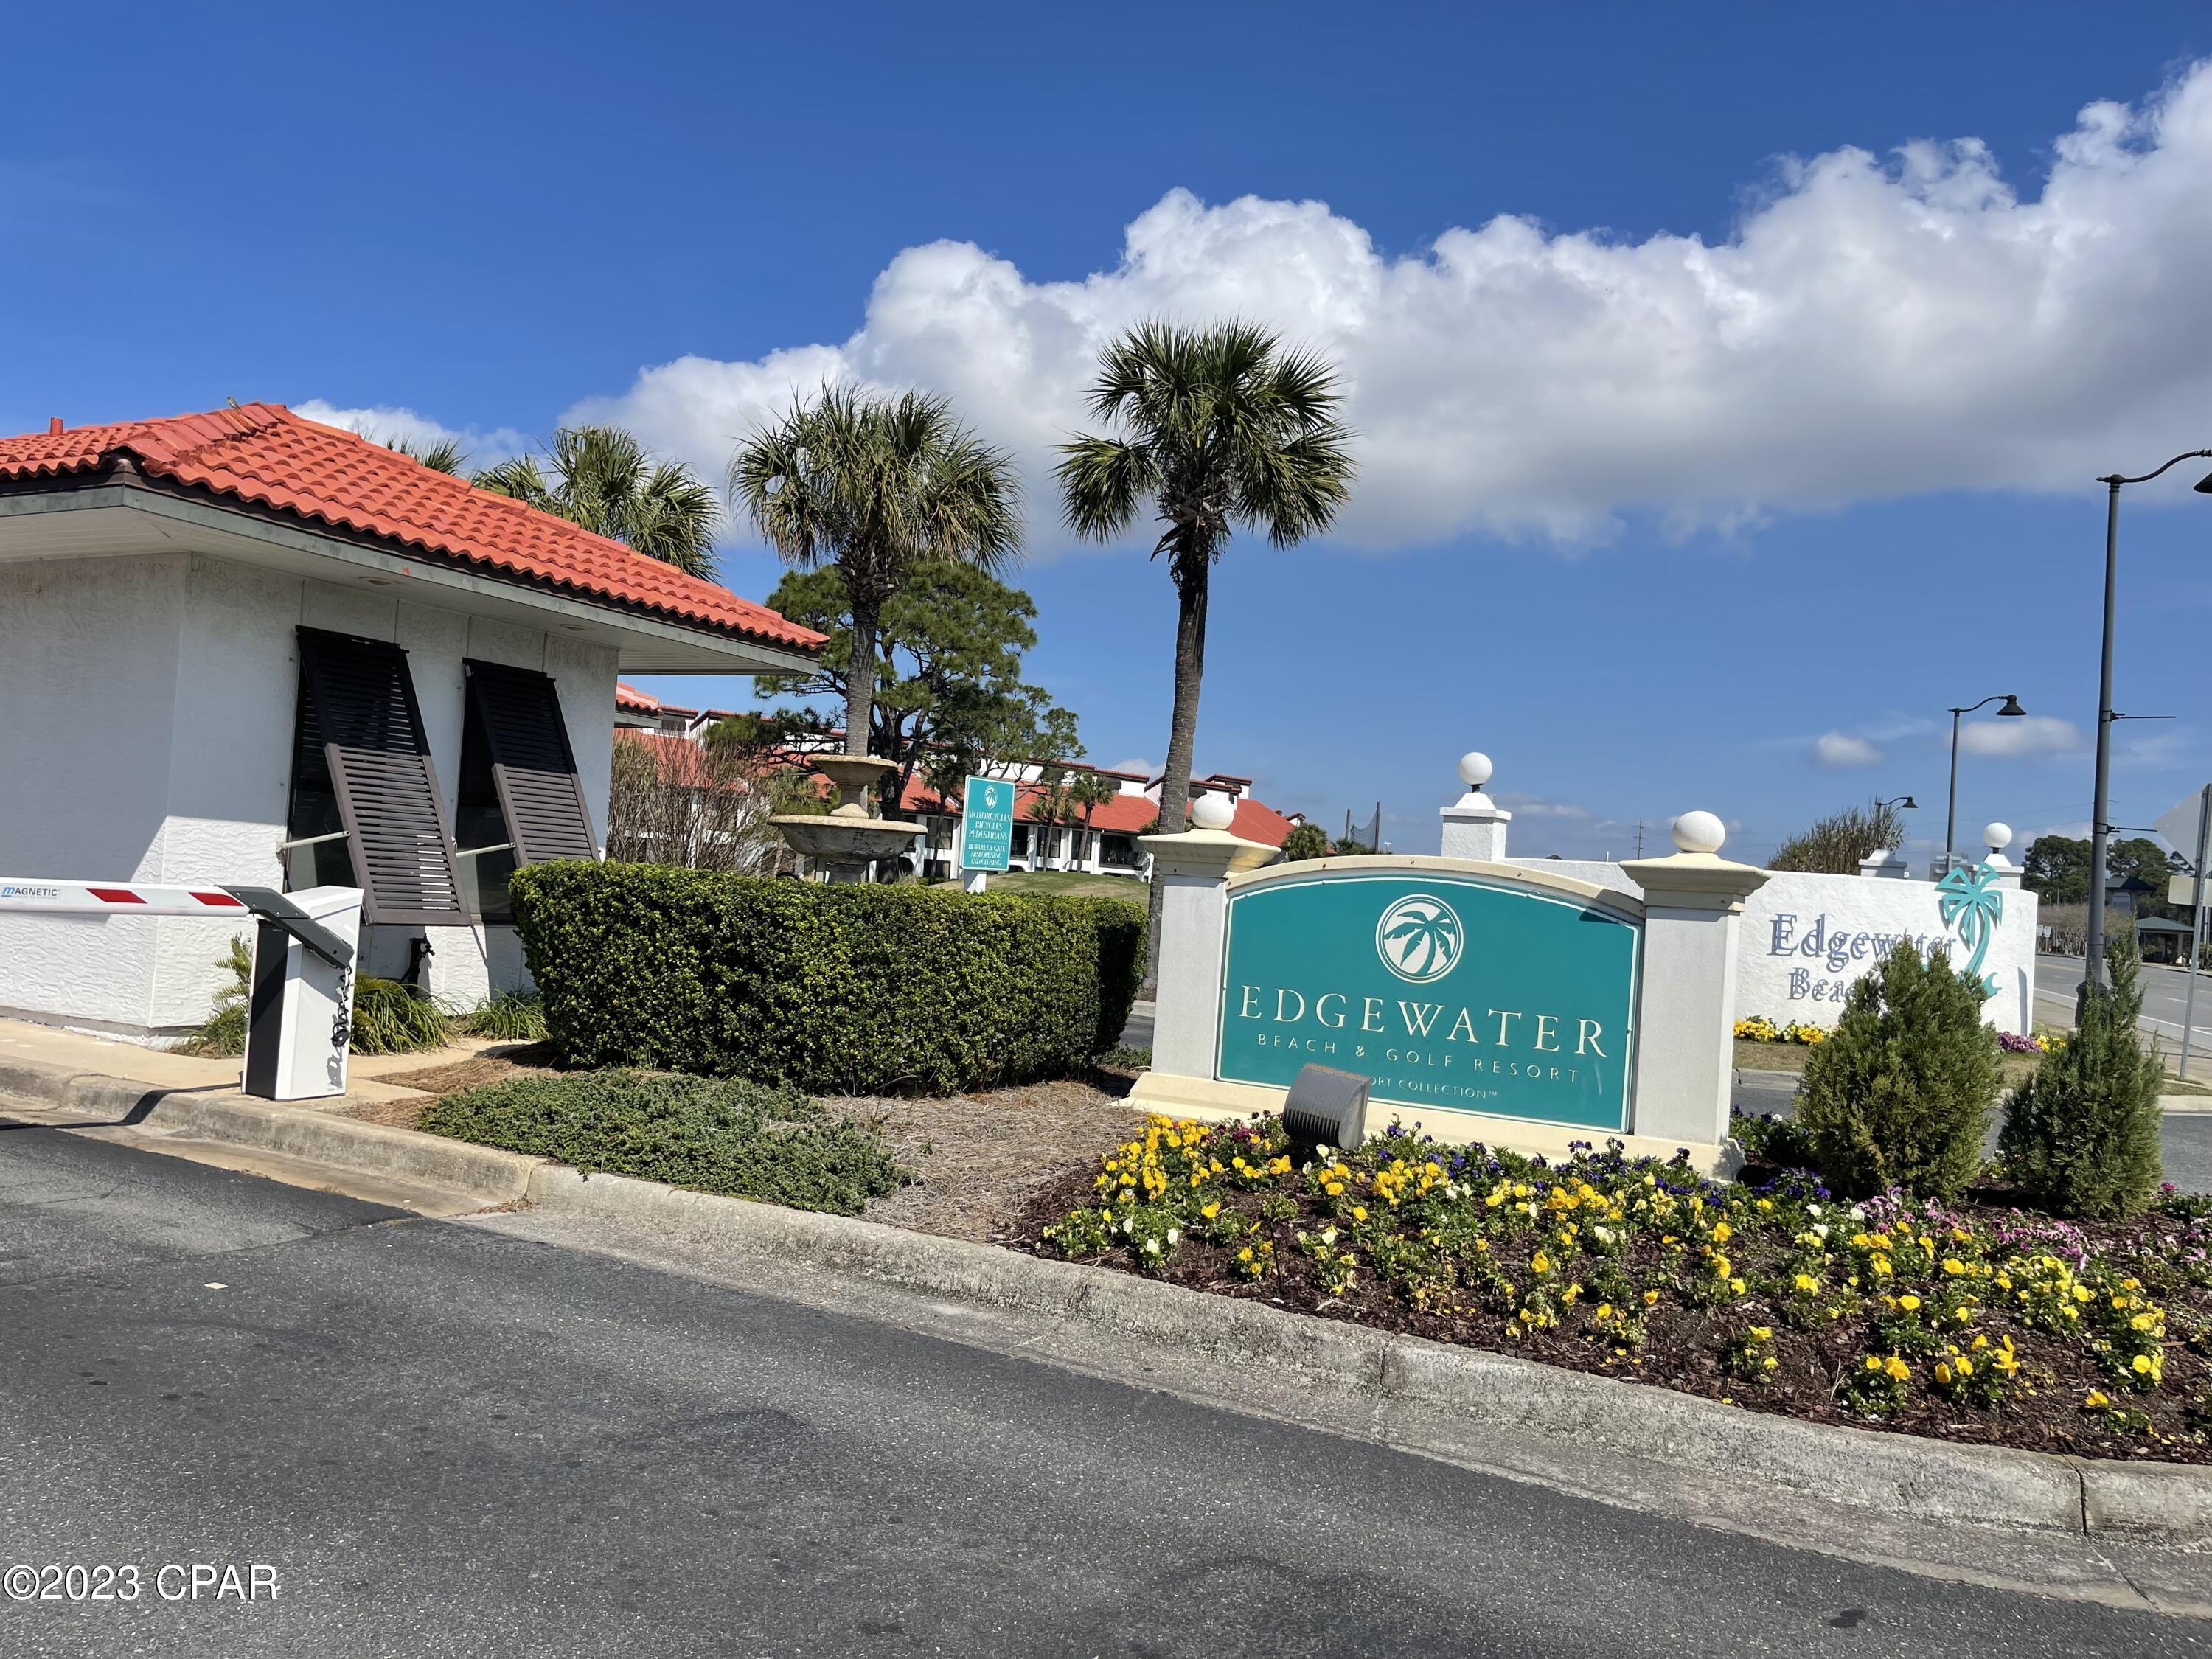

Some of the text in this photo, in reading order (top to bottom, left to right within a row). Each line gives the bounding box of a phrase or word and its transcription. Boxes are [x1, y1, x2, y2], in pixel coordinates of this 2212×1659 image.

[968, 810, 1011, 822] MOTORCYCLES
[975, 821, 1003, 831] BICYCLES
[968, 829, 1007, 840] PEDESTRIANS
[1239, 985, 1607, 1058] EDGEWATER
[1258, 1033, 1580, 1082] BEACH & GOLF RESORT
